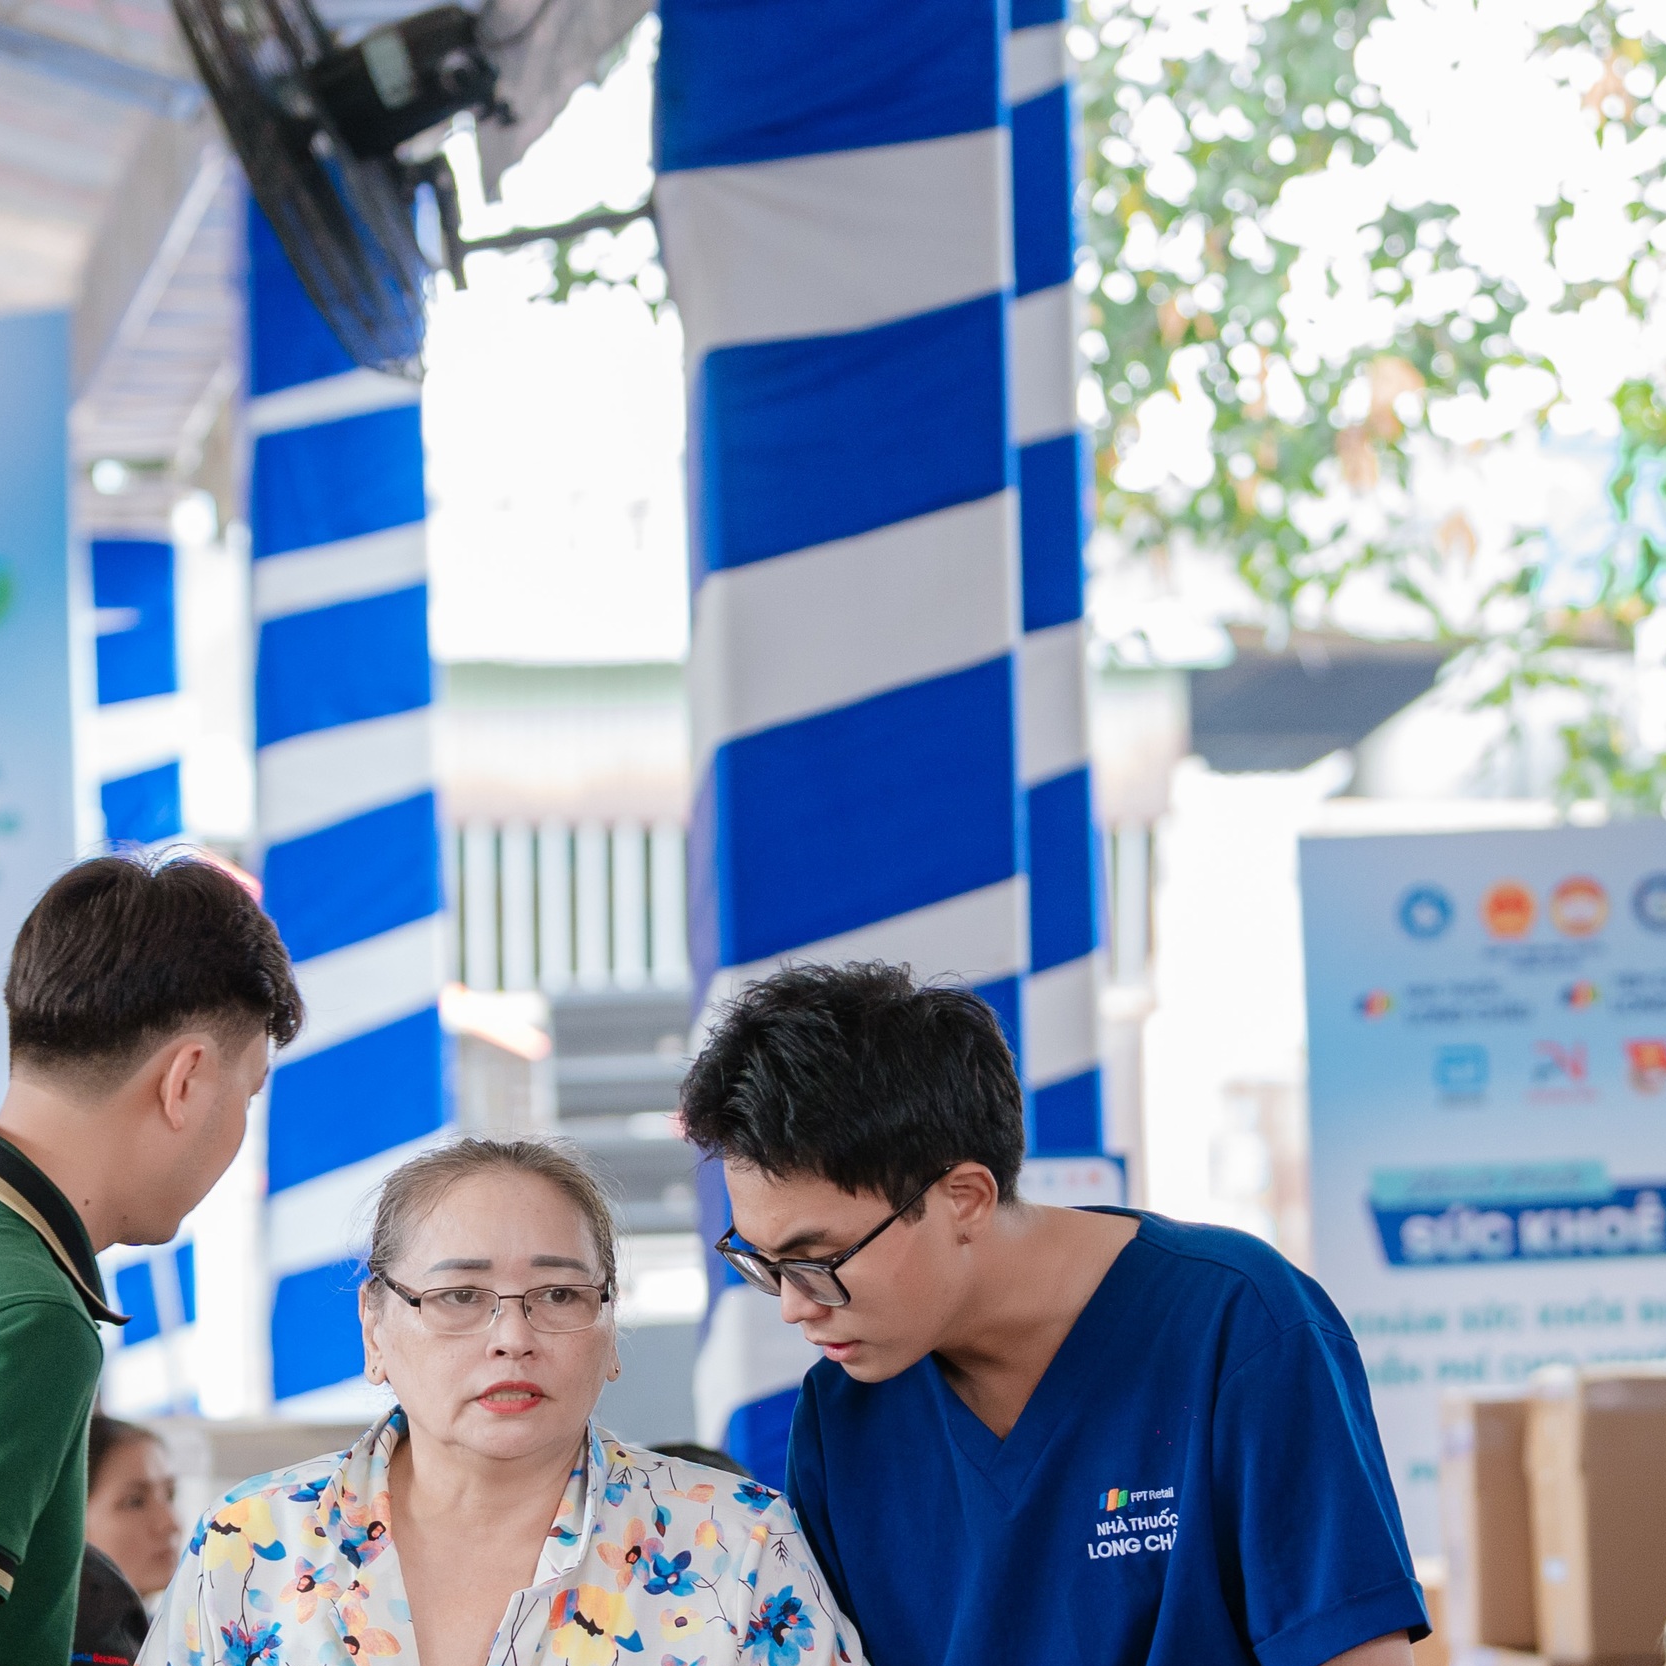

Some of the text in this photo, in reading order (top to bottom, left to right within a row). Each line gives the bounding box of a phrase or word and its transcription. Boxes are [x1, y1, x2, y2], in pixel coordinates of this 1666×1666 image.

[1130, 1487, 1175, 1503] FPT Retail
[1096, 1508, 1180, 1536] NHÀ THUỐC
[1088, 1537, 1142, 1559] LONG
